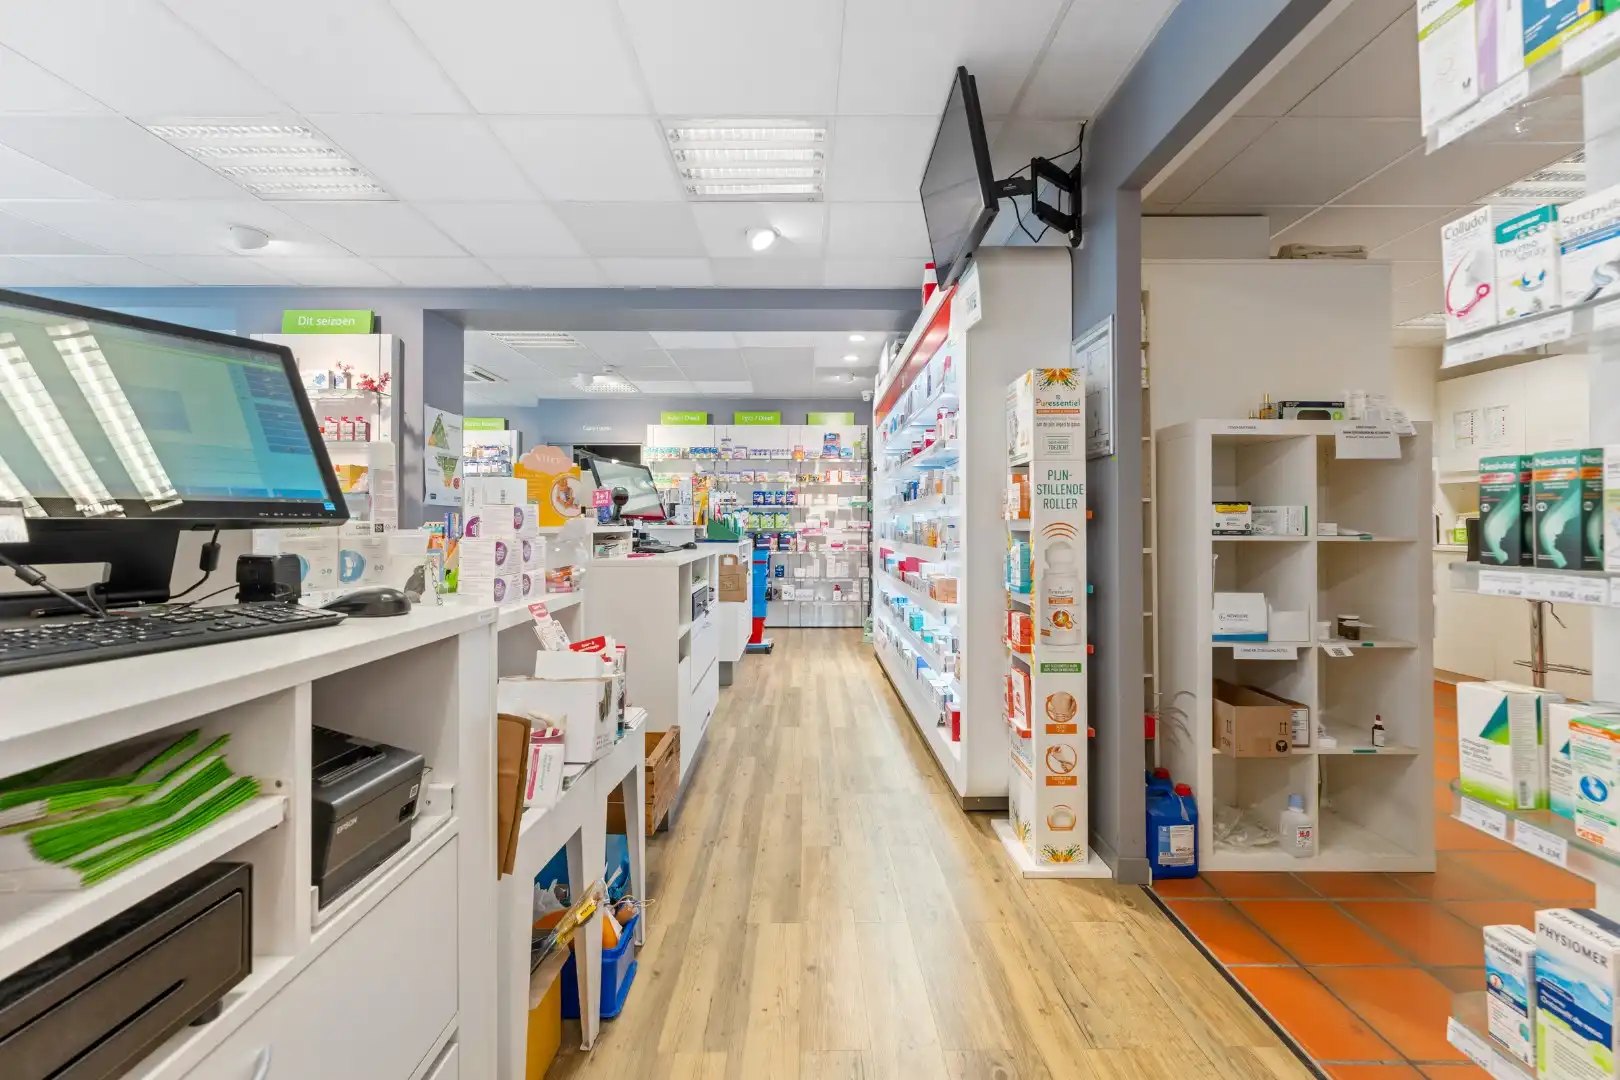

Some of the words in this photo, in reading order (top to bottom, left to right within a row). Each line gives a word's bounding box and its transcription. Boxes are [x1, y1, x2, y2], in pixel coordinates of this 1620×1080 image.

[1444, 210, 1488, 240] Colludol
[297, 316, 314, 326] Dit
[316, 316, 356, 327] seizoen
[1035, 398, 1081, 407] Puressentiel
[1047, 469, 1073, 481] PIJN-
[595, 491, 608, 500] 1+1
[1036, 483, 1084, 496] STILLENDE
[1043, 498, 1078, 510] ROLLER
[1538, 922, 1609, 969] PHYSIOMER
